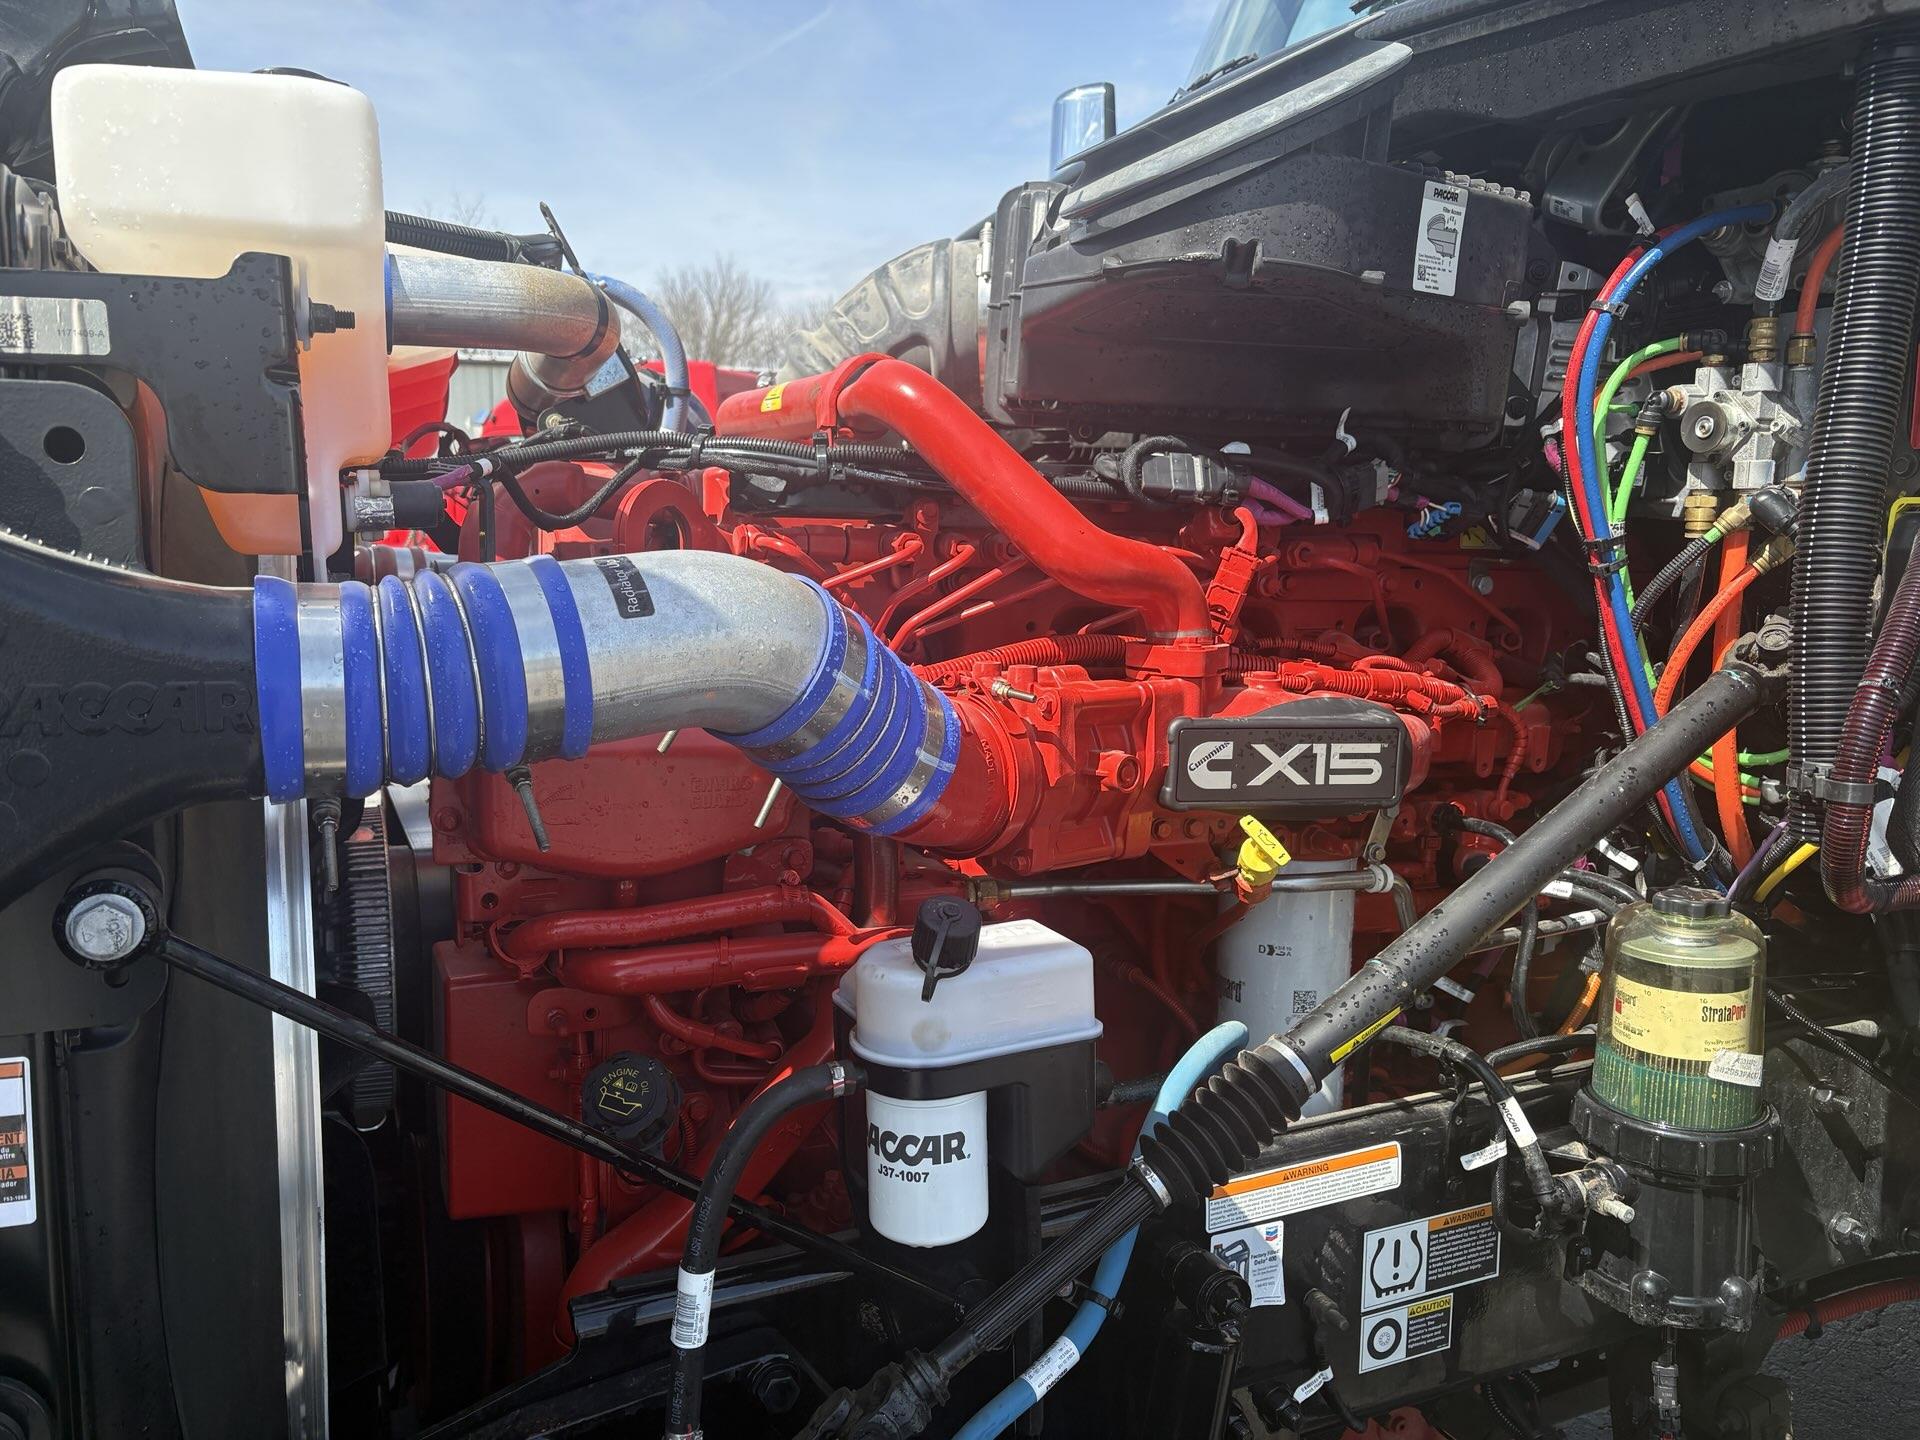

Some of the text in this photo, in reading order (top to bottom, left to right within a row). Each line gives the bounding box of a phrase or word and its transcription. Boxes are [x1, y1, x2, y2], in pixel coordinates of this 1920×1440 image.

[1433, 188, 1459, 202] PACCAR
[616, 568, 641, 613] Radiator
[1188, 741, 1231, 772] Cummins
[1247, 743, 1382, 785] X15
[1701, 1005, 1747, 1023] StrataPore
[1361, 1022, 1382, 1040] CAUTION
[602, 1068, 650, 1096] ENGINE OIL
[1500, 1102, 1520, 1133] PACCAR
[867, 1122, 966, 1167] ACCAR
[878, 1164, 930, 1183] J37-1007
[1289, 1163, 1329, 1179] WARNING
[1449, 1209, 1486, 1222] WARNING
[692, 1237, 702, 1256] USA
[1416, 1299, 1450, 1314] CAUTION
